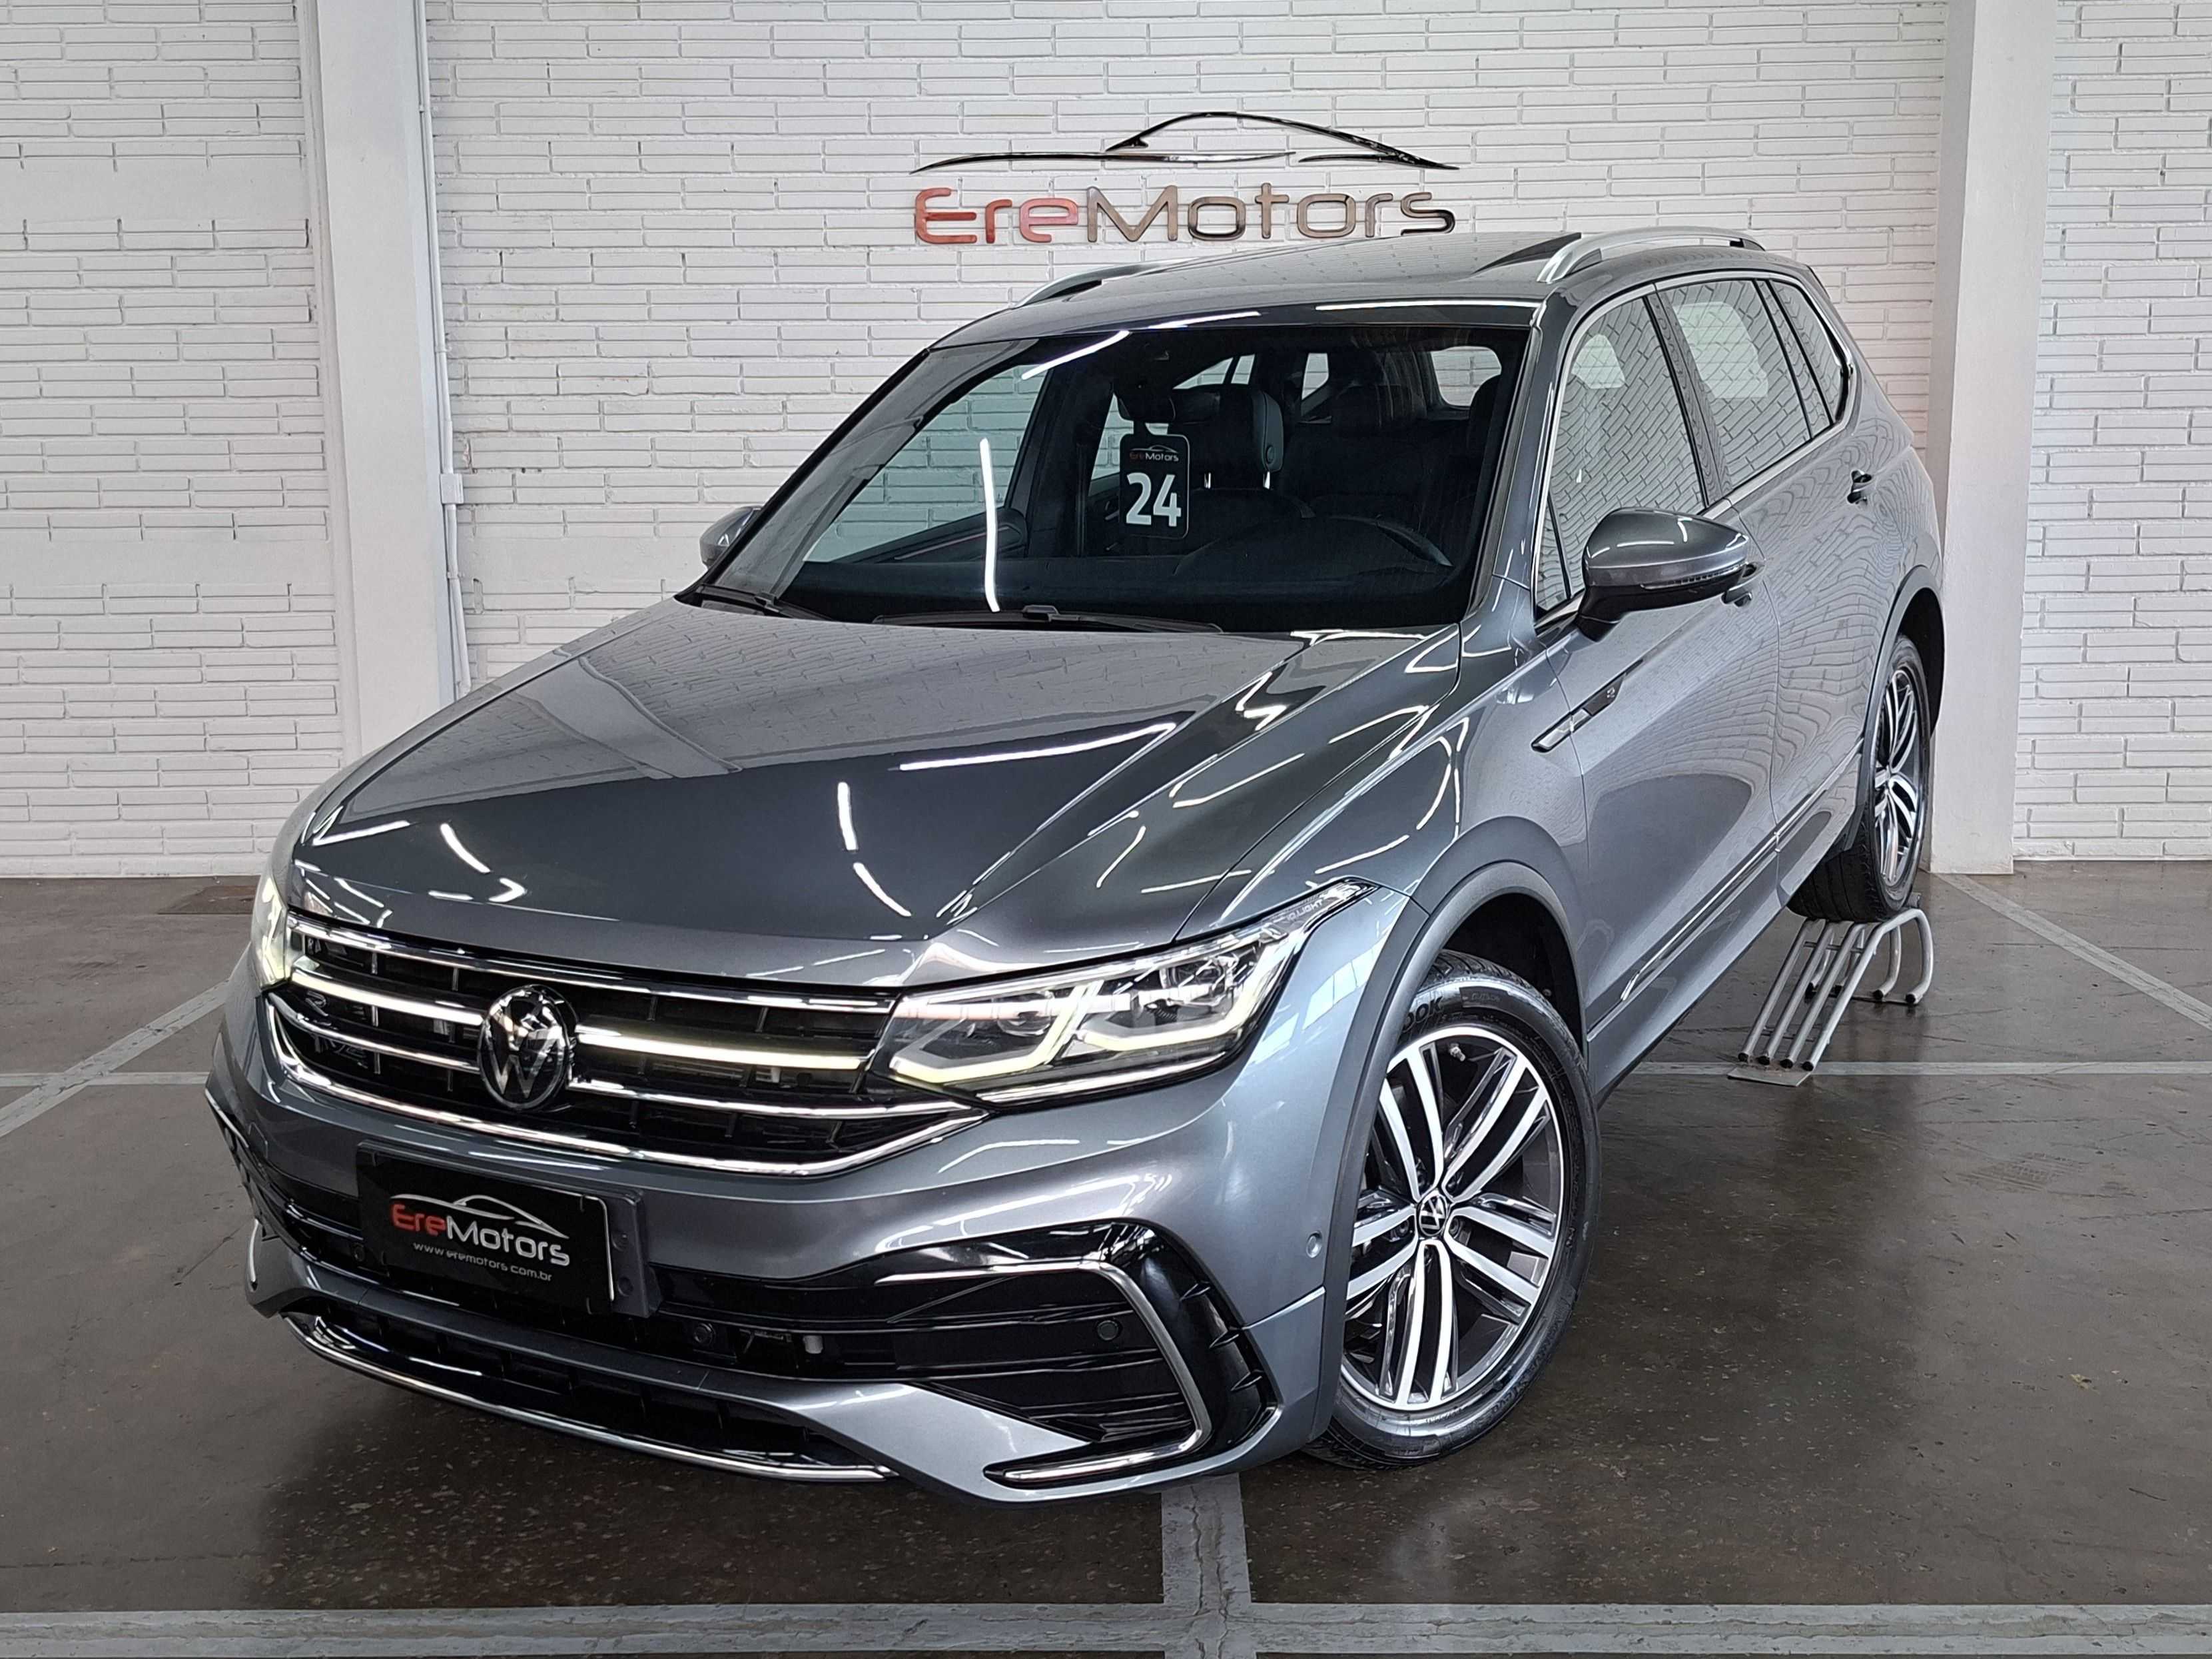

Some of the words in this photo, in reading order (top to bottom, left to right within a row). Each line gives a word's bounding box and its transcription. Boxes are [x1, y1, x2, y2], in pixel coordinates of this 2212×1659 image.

[914, 183, 1457, 245] EreMotors
[1130, 452, 1179, 462] ErMotors
[1126, 472, 1182, 527] 24
[392, 1204, 571, 1266] EreMotors
[412, 1242, 553, 1282] wwweremotorscom.br
